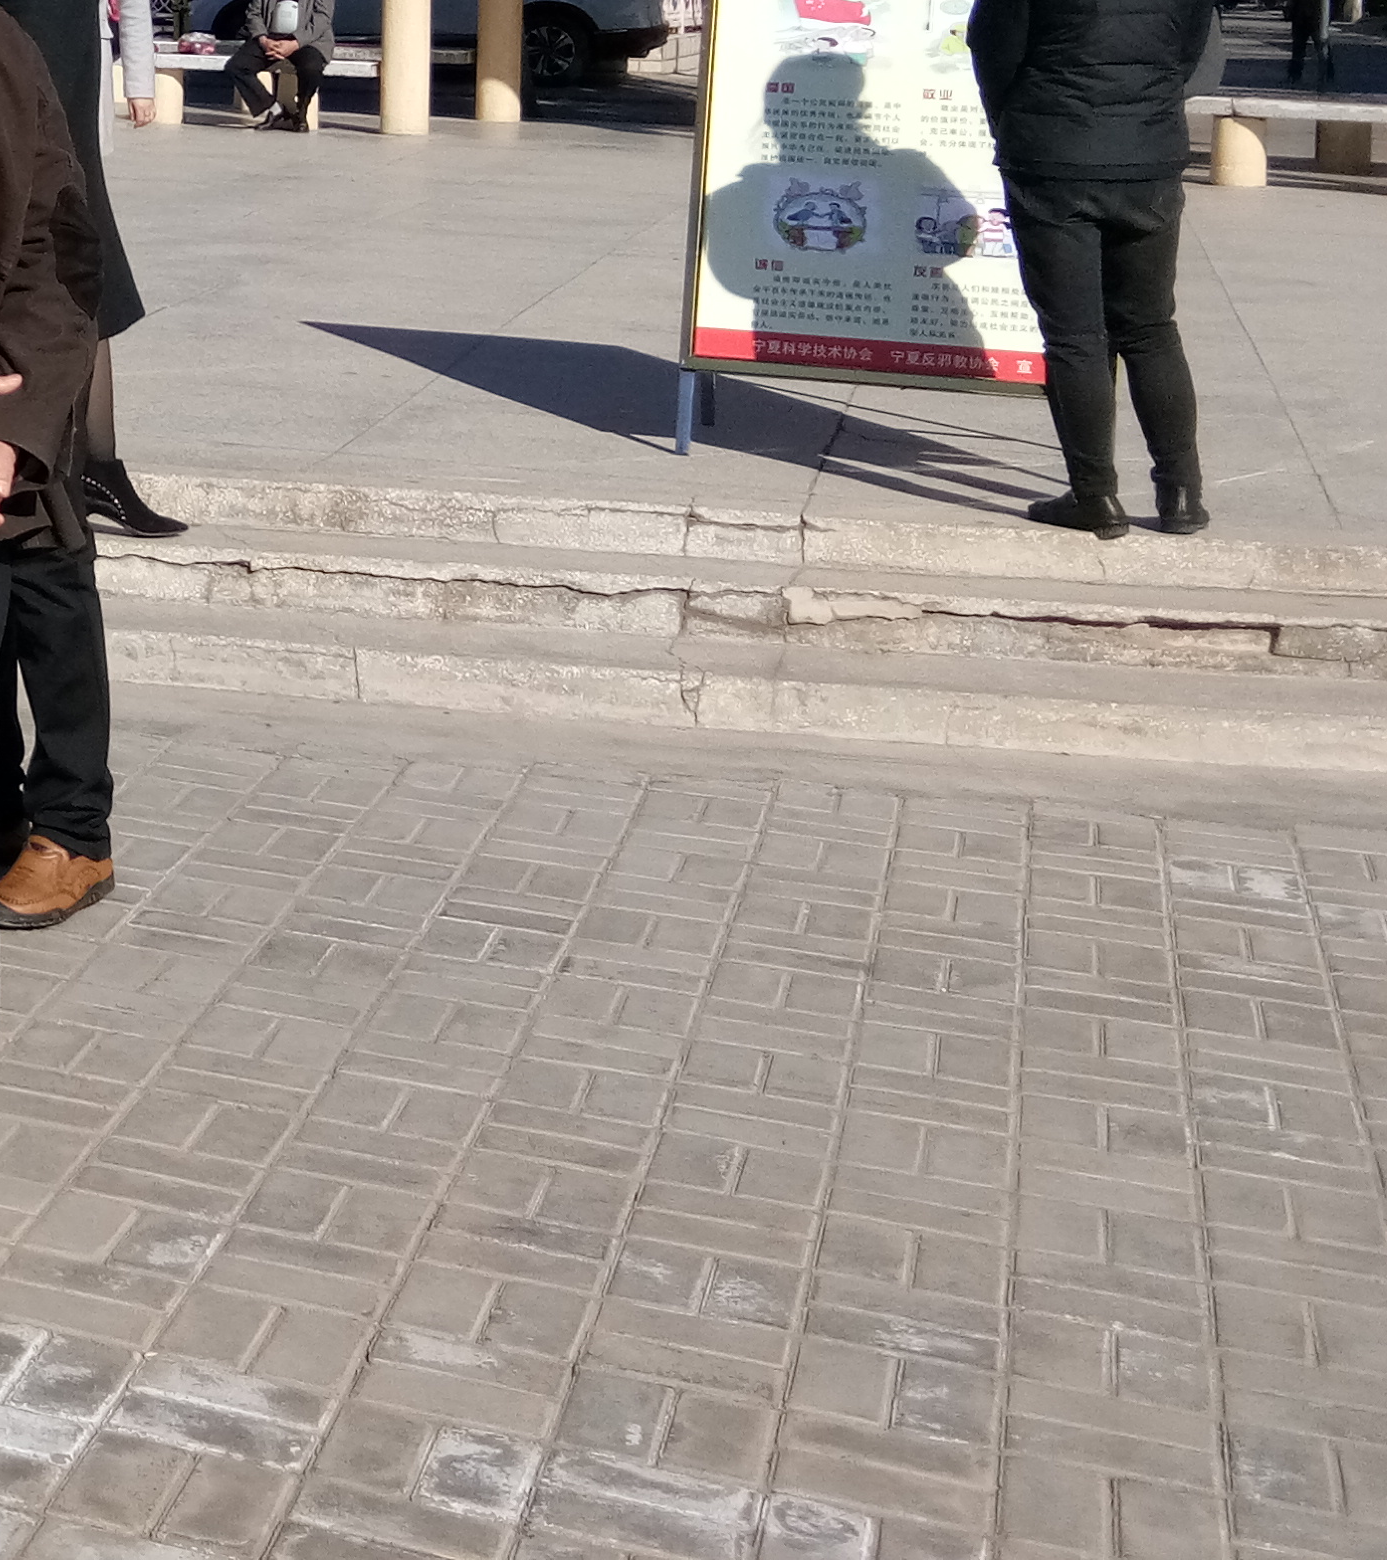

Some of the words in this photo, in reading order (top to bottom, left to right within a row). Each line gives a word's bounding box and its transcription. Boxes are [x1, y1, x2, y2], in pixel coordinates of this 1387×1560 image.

[753, 339, 874, 361] 宁夏科学技术协会
[890, 349, 999, 372] 宁夏反邪教协会
[1016, 358, 1033, 374] 宣
